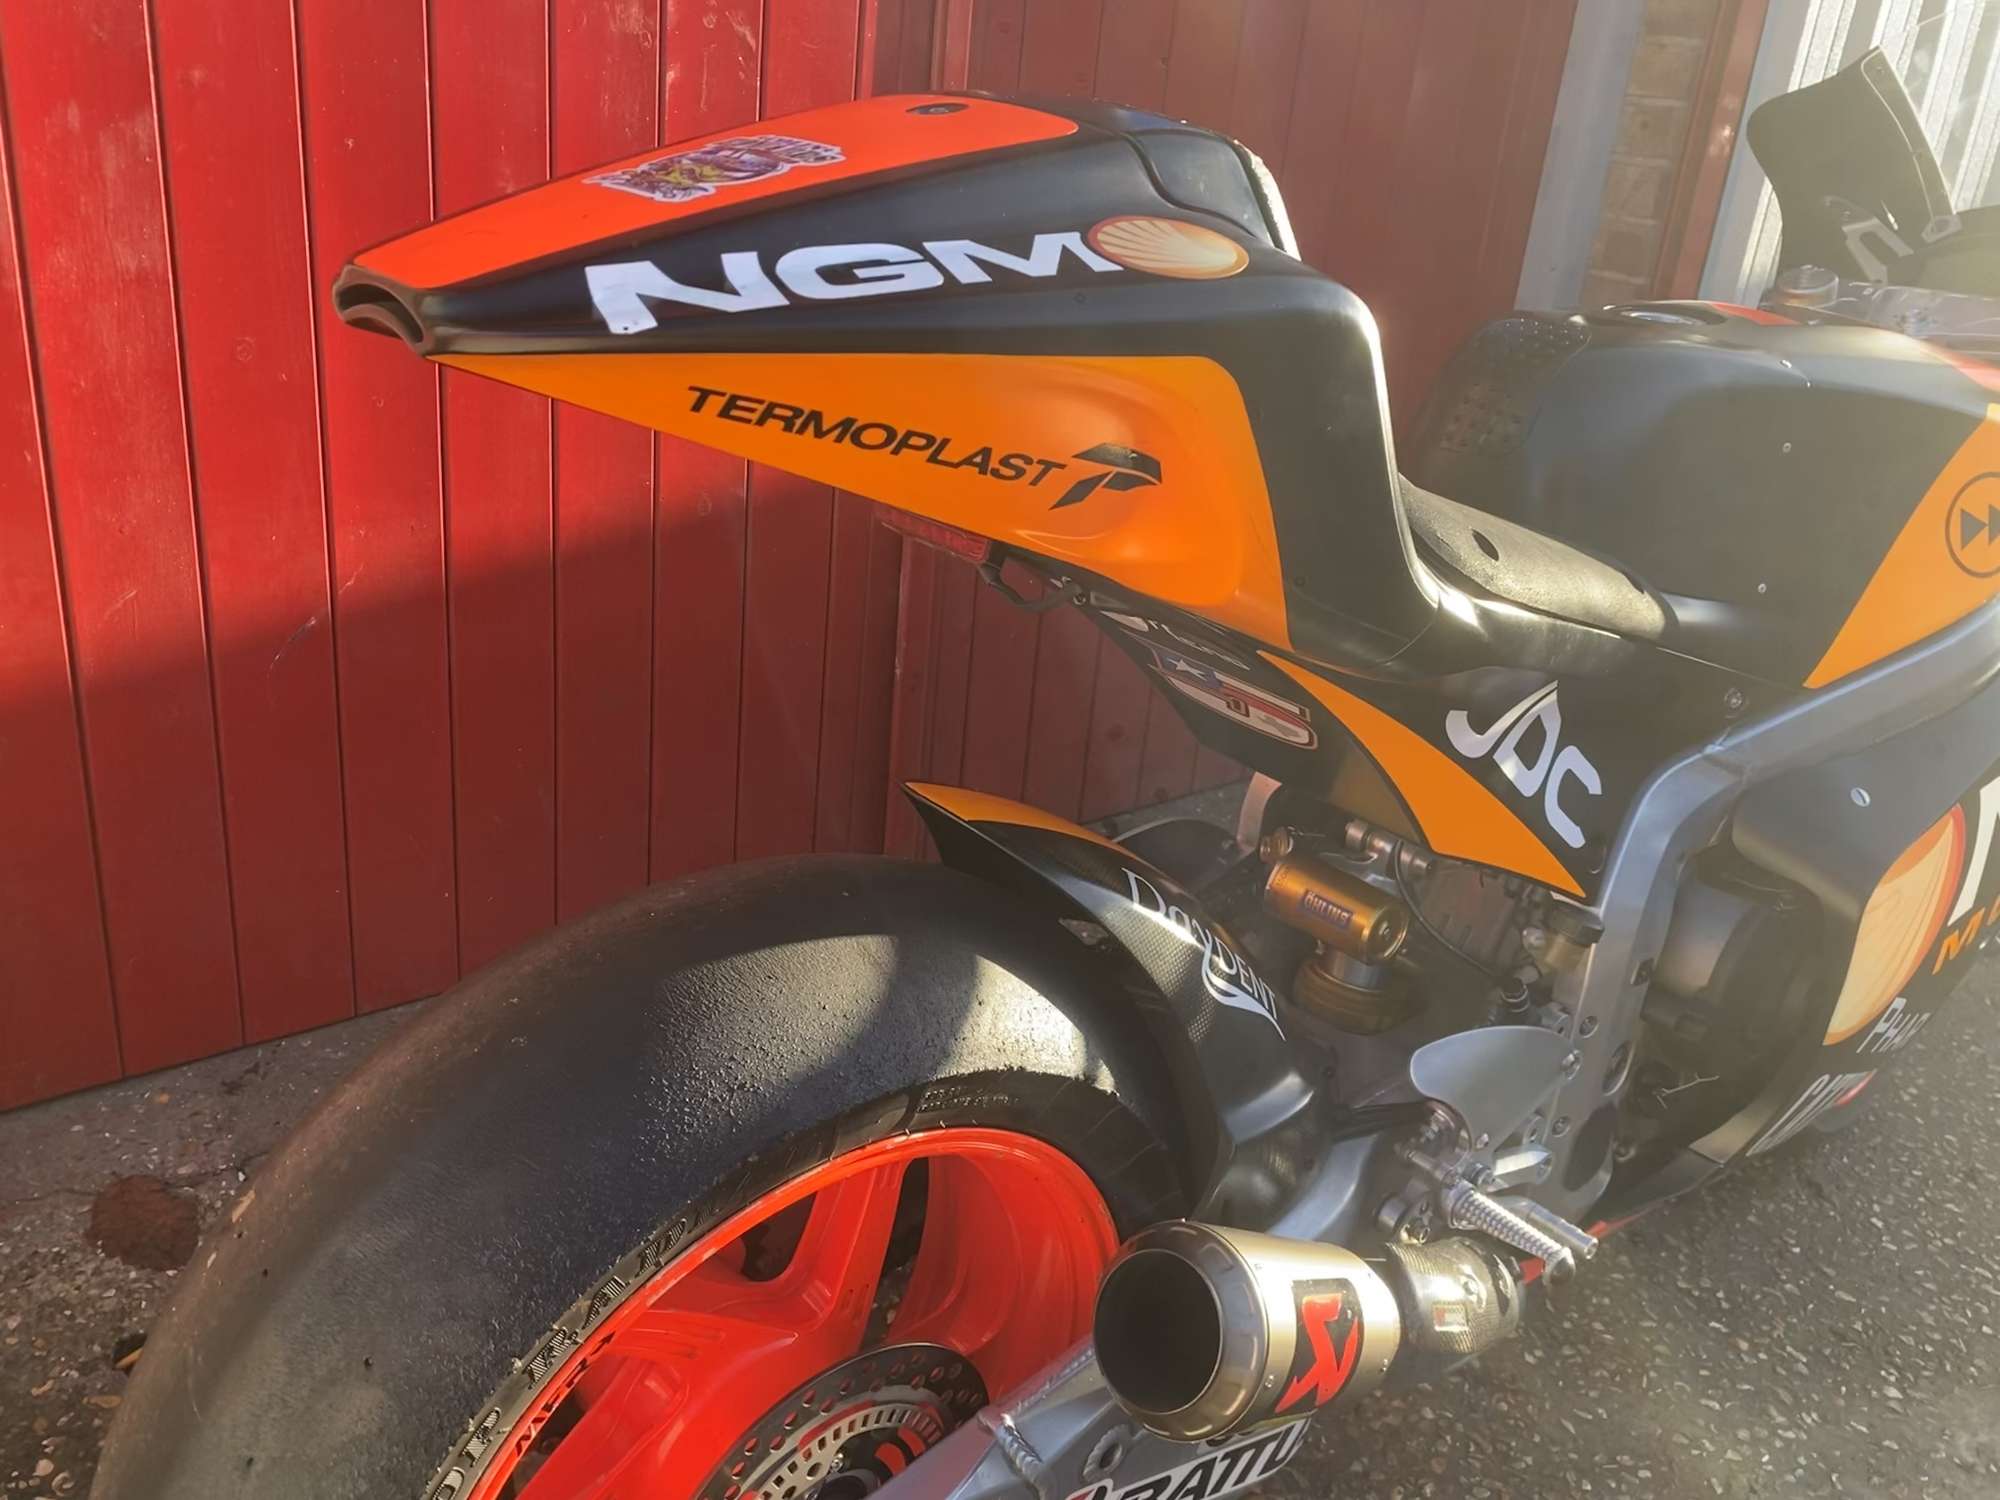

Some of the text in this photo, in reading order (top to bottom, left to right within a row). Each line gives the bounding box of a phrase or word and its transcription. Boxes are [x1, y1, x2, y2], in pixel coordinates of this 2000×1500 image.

[586, 231, 1123, 334] NGM
[687, 385, 1067, 487] TERMOPLAST
[1446, 680, 1602, 849] JDC
